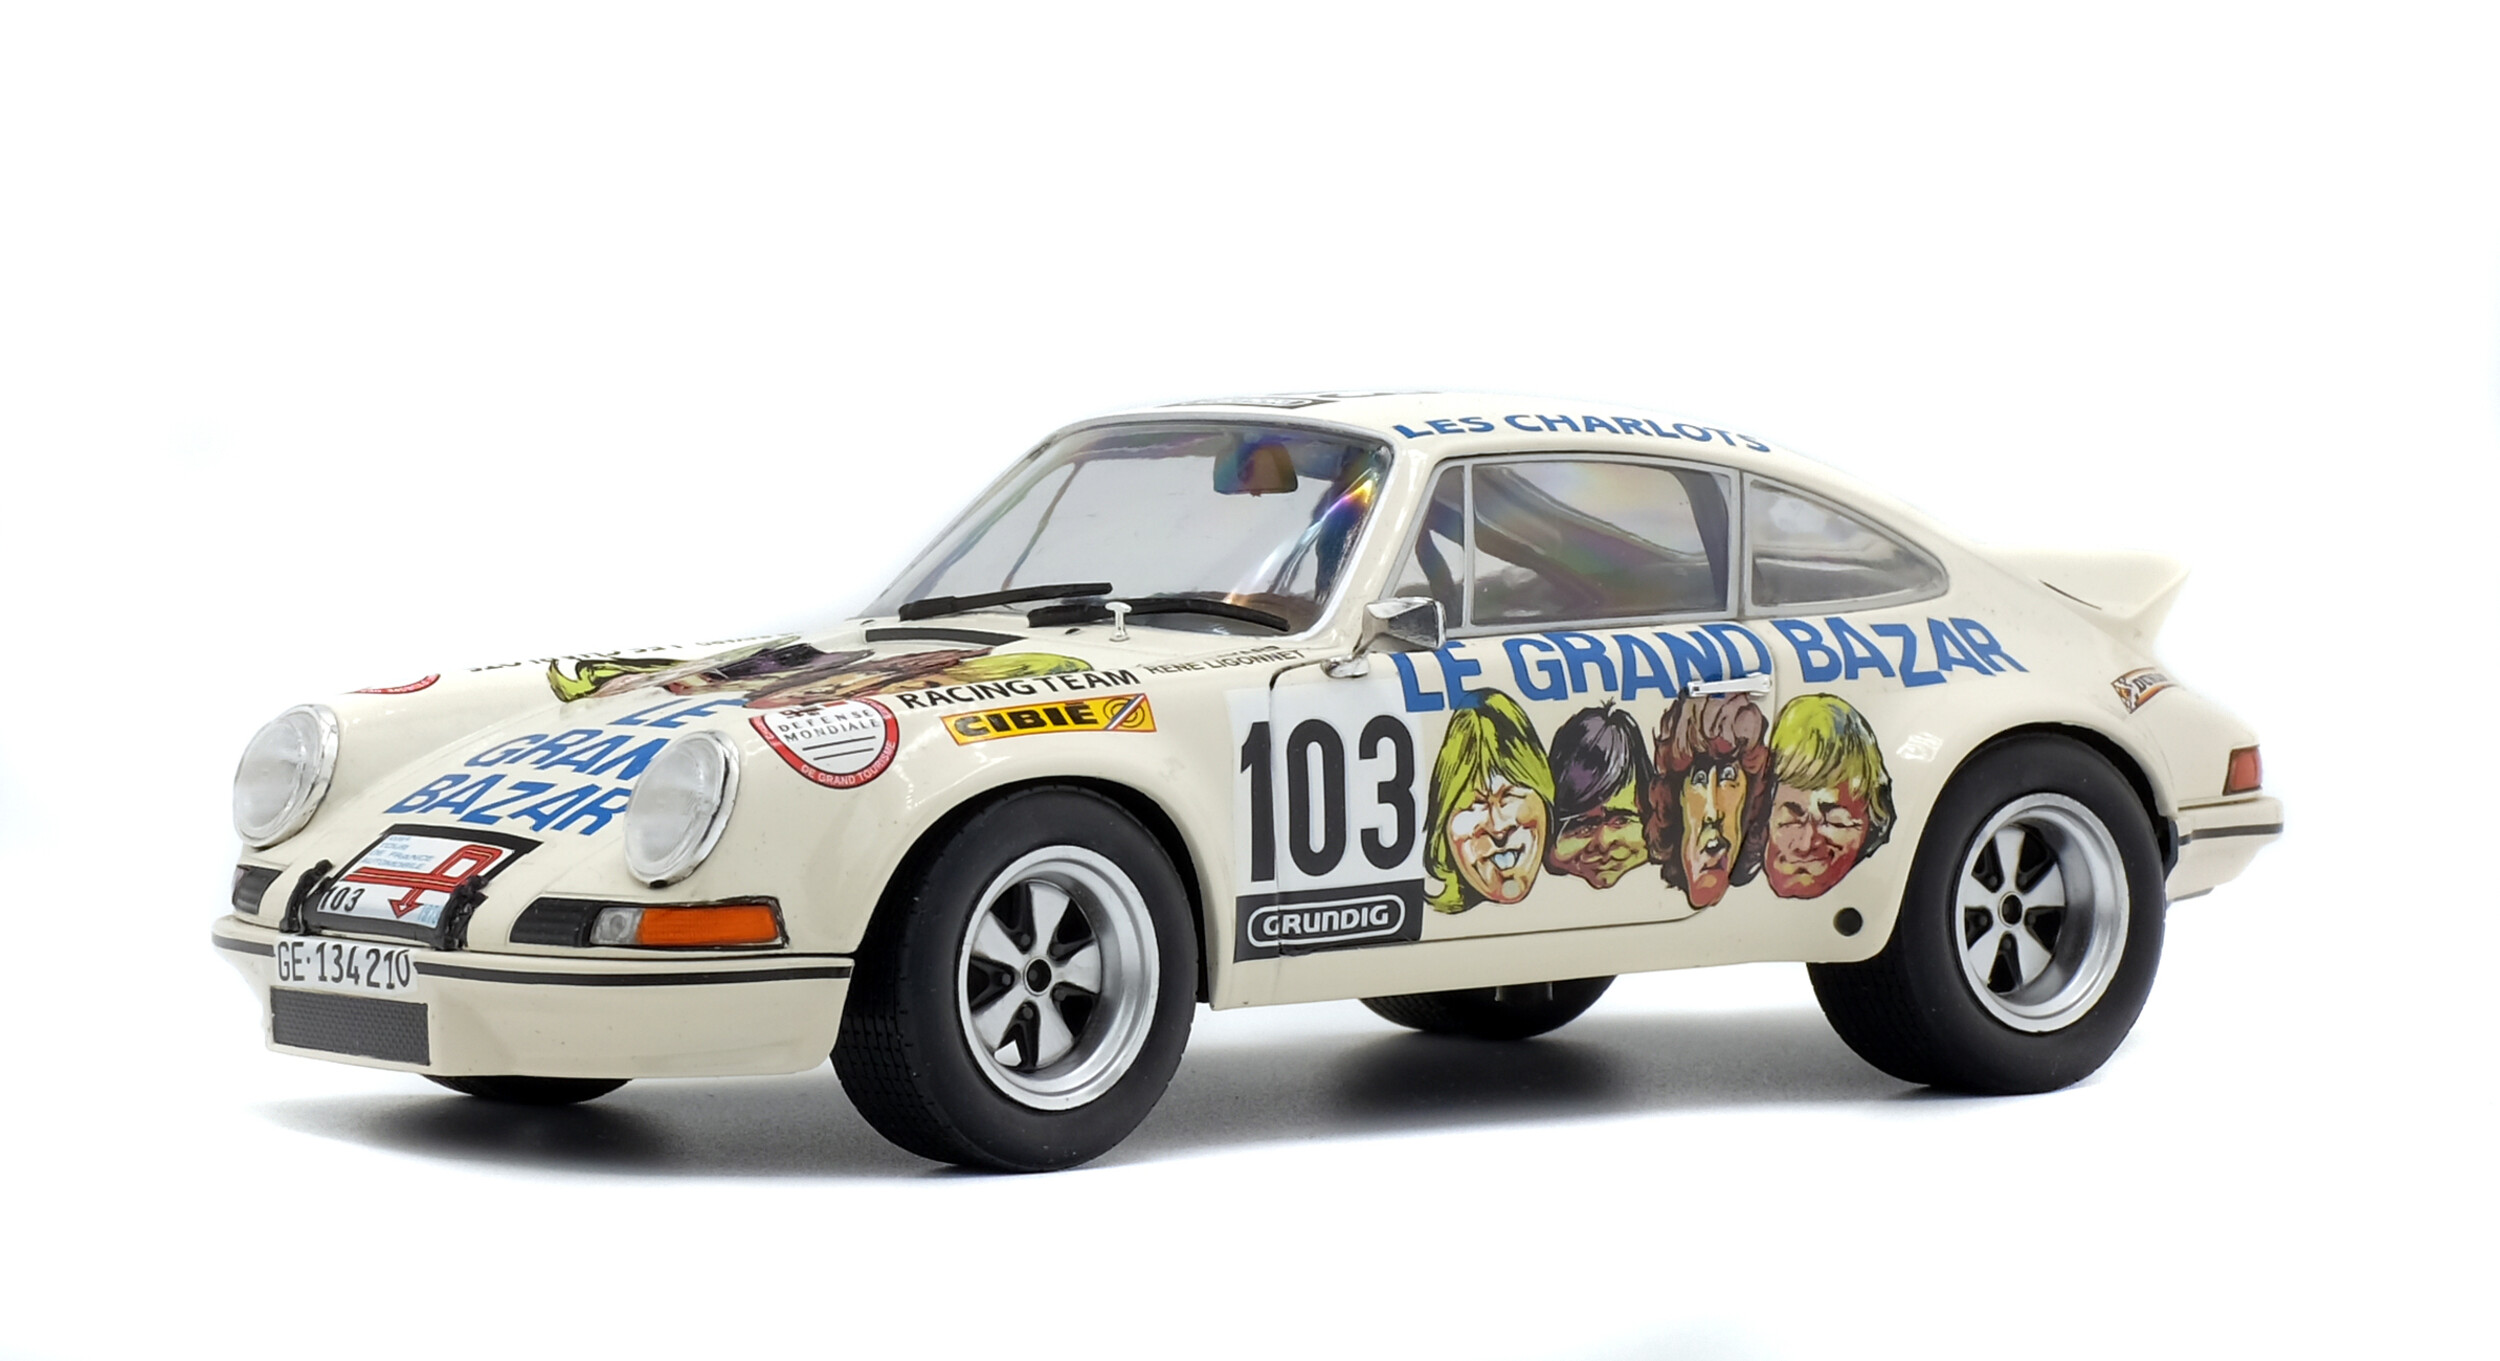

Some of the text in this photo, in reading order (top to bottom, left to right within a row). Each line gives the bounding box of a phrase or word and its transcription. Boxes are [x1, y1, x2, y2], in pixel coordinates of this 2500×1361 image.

[1392, 414, 1771, 454] LES CHARLOTS
[1204, 648, 1306, 669] LIGONNET
[1393, 617, 2030, 713] LE GRAND BAZAR
[898, 676, 1034, 711] RACING
[1035, 668, 1141, 693] TEAM
[606, 697, 749, 729] LE
[784, 719, 883, 743] MONDIALE
[463, 729, 672, 780] GRAN
[817, 774, 857, 788] GRAND
[857, 740, 896, 781] TOURISME
[383, 773, 632, 836] BAZAR
[1240, 714, 1416, 882] 103
[319, 886, 365, 912] 103
[1262, 904, 1389, 937] GRUNDIG
